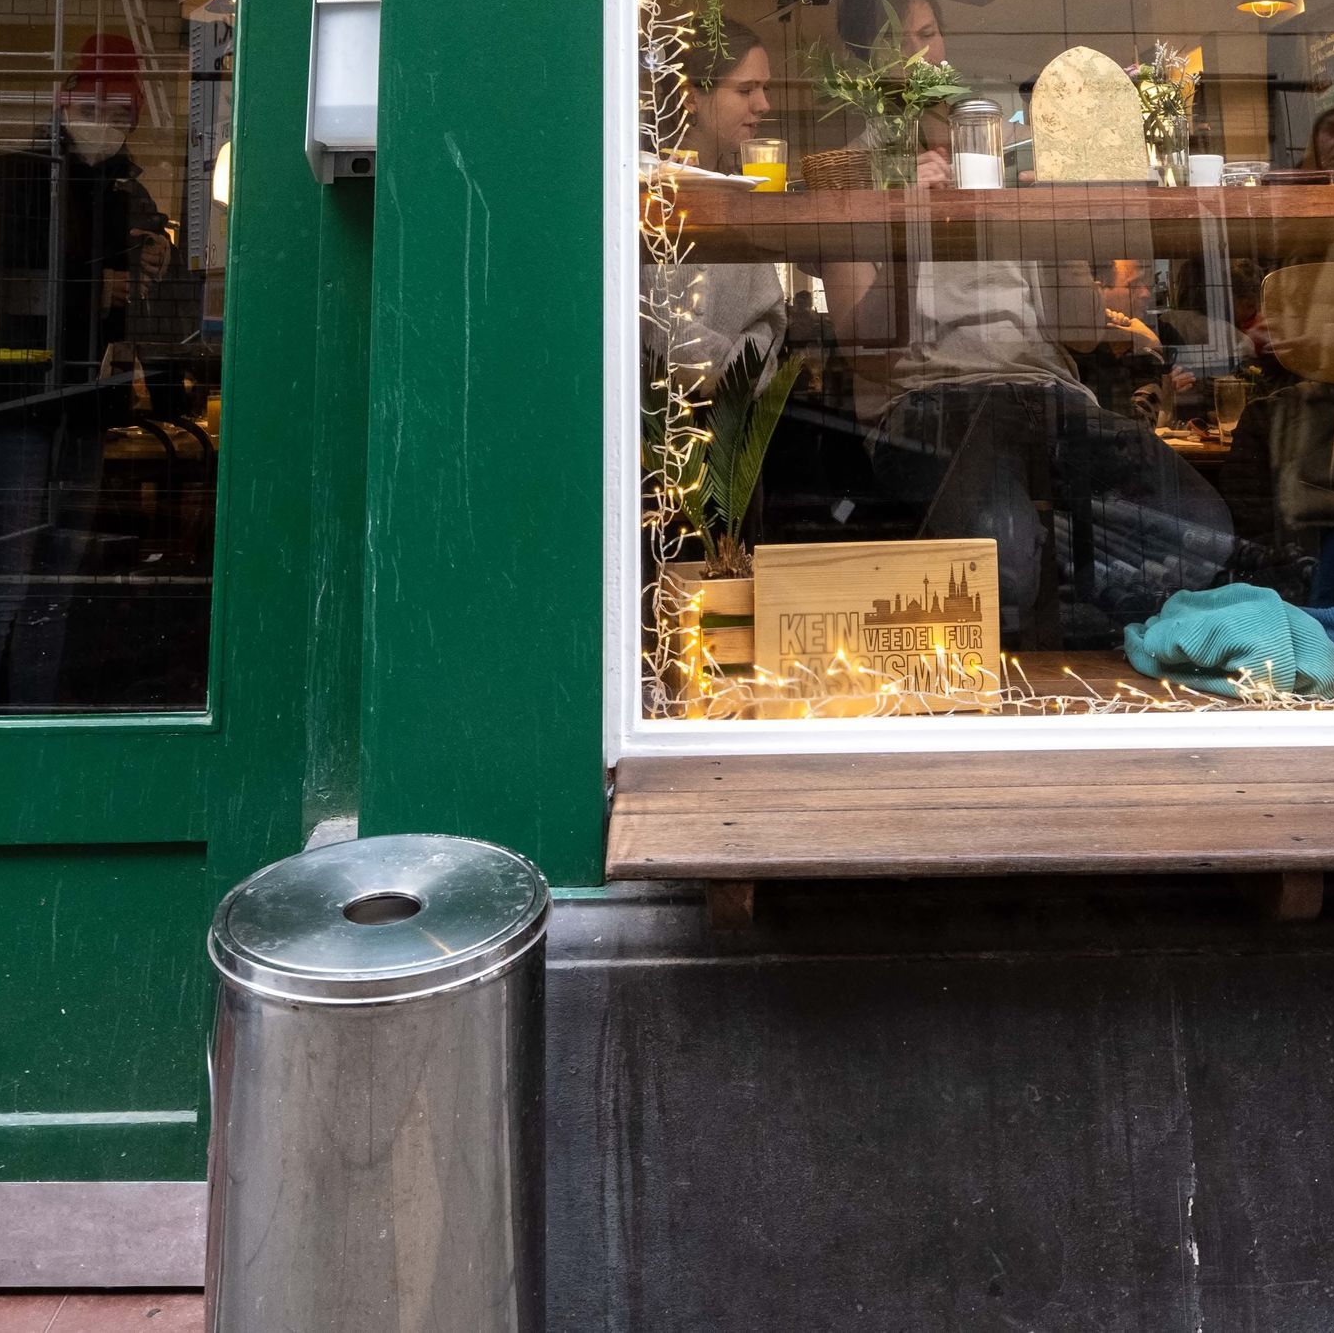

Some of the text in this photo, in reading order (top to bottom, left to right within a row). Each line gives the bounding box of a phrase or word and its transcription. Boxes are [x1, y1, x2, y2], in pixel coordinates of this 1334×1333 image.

[780, 612, 860, 655] KEIN
[862, 618, 983, 653] VEEDEL FÜR
